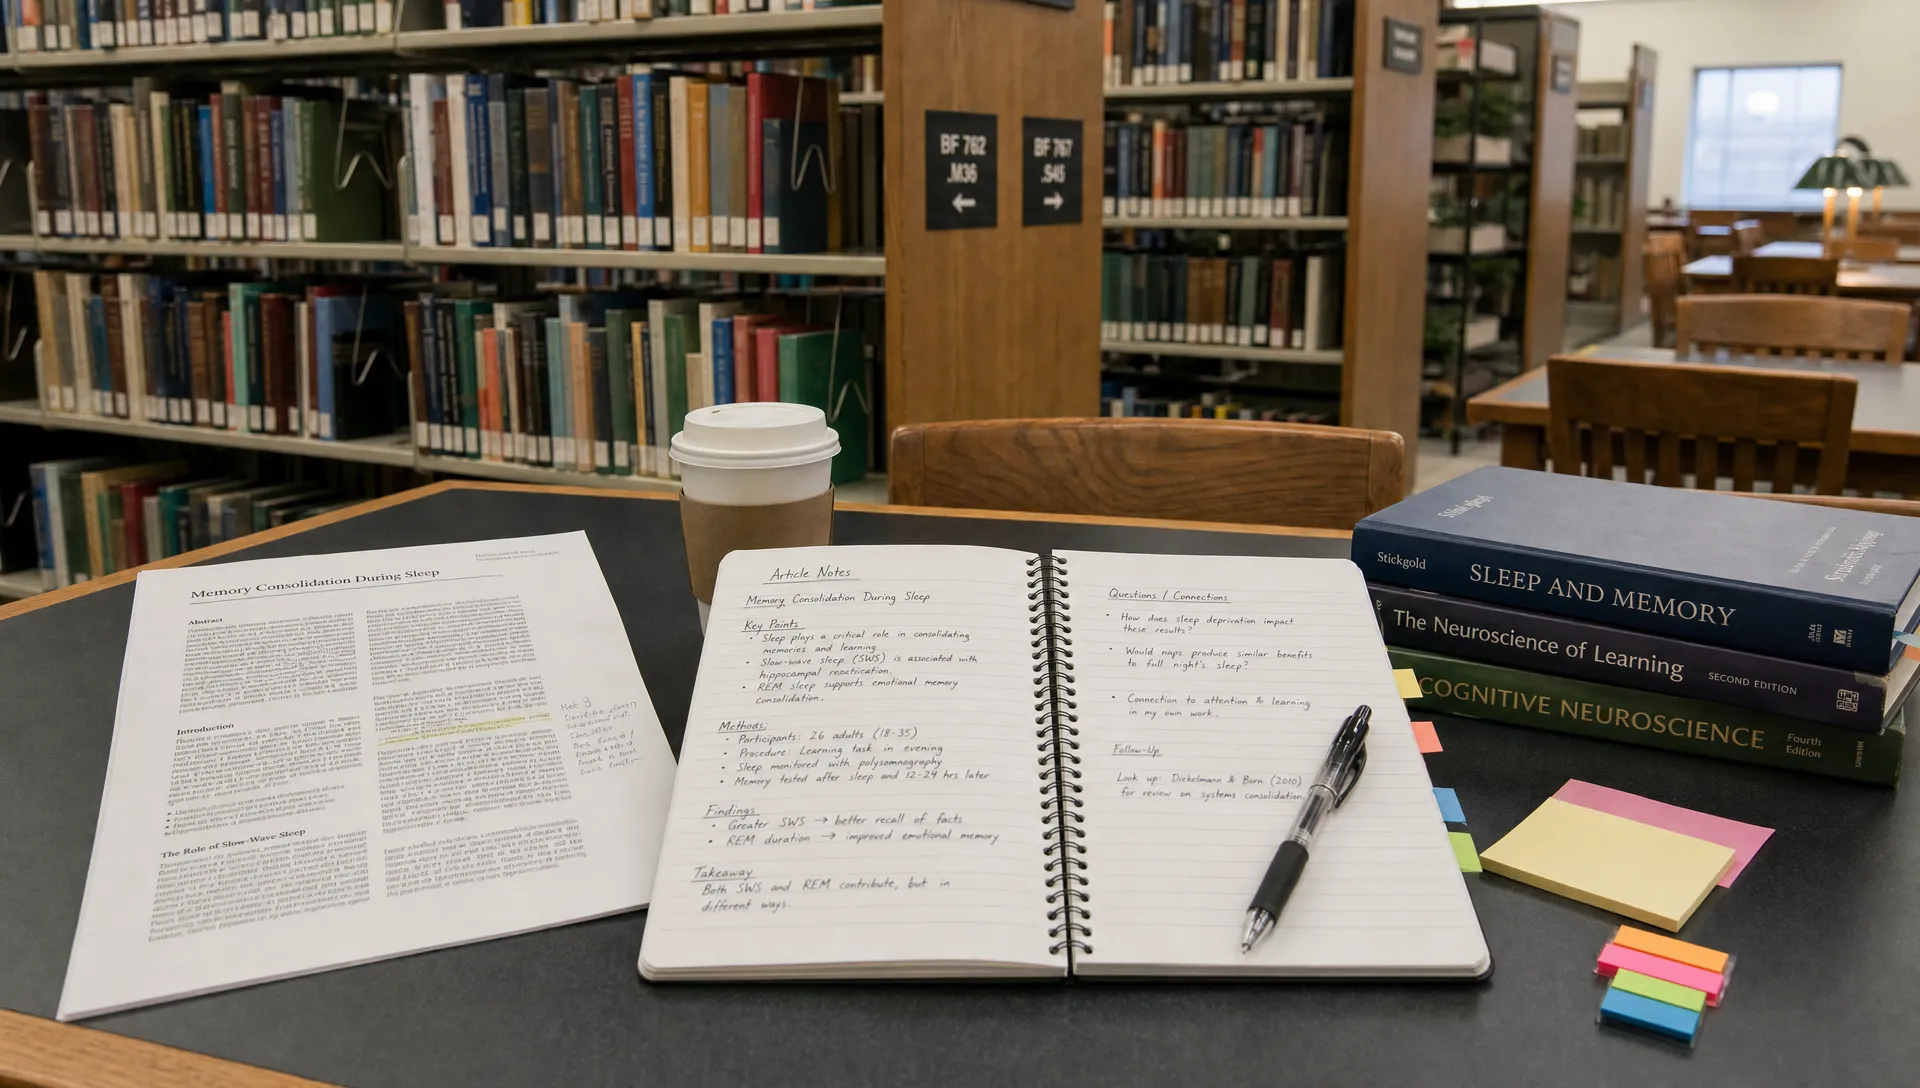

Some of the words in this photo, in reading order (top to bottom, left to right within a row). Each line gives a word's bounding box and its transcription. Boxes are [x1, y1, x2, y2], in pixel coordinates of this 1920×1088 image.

[940, 133, 959, 154] BF
[963, 135, 987, 156] 762
[1034, 138, 1051, 157] BF
[947, 163, 978, 183] .M36
[1377, 550, 1427, 570] Stickgold
[770, 567, 810, 581] Article
[817, 565, 851, 578] Notes
[191, 586, 252, 599] Memory
[256, 576, 351, 592] Consolidation
[355, 572, 401, 586] During
[405, 570, 440, 581] Sleep
[792, 593, 855, 604] Consolidation
[863, 592, 897, 606] During
[904, 590, 931, 603] Sleep
[1109, 588, 1157, 600] Questions
[1163, 589, 1168, 600] /
[1173, 591, 1228, 602] Connections
[1470, 564, 1541, 592] SLEEP
[1547, 579, 1605, 605] AND
[1612, 588, 1736, 628] MEMORY
[188, 617, 223, 626] Abstract
[744, 620, 763, 635] Key
[769, 619, 799, 629] Points
[1121, 613, 1140, 622] How
[1148, 614, 1167, 623] does
[1176, 615, 1200, 626] sleep
[1207, 615, 1256, 627] deprivation
[1264, 617, 1295, 626] impact
[1124, 625, 1147, 633] these
[1155, 626, 1193, 634] results?
[762, 632, 786, 645] Sleep
[790, 633, 814, 644] plays
[833, 630, 865, 639] critical
[872, 630, 889, 638] role
[913, 630, 970, 641] consolidating
[763, 645, 806, 654] memories
[815, 643, 832, 651] and
[1126, 647, 1154, 656] Would
[1161, 650, 1183, 660] naps
[1192, 650, 1228, 660] produce
[1237, 650, 1268, 658] similar
[1276, 650, 1313, 659] benefits
[1393, 609, 1427, 631] The
[1434, 616, 1558, 656] Neuroscience
[1566, 640, 1587, 659] of
[1594, 645, 1684, 683] Learning
[760, 657, 812, 666] Slow-wave
[820, 655, 844, 667] sleep
[852, 652, 886, 664] (SWS)
[893, 655, 901, 663] is
[908, 654, 952, 663] associated
[959, 655, 977, 663] with
[1128, 658, 1137, 667] to
[1147, 659, 1164, 667] full
[1174, 659, 1206, 671] night's
[1217, 660, 1249, 671] sleep?
[759, 667, 821, 683] hippocampal
[757, 682, 782, 691] REM
[790, 681, 816, 693] sleep
[824, 678, 863, 690] supports
[872, 678, 917, 687] emotional
[925, 679, 958, 690] memory
[1708, 671, 1749, 690] SECOND
[1753, 678, 1797, 695] EDITION
[756, 693, 824, 704] consolidation.
[1128, 694, 1177, 704] Connection
[1187, 695, 1196, 704] to
[1204, 696, 1248, 705] attention
[1145, 711, 1157, 719] my
[1419, 677, 1550, 715] COGNITIVE
[1560, 699, 1765, 749] NEUROSCIENCE
[176, 723, 234, 735] Introduction
[738, 732, 801, 745] Participants:
[809, 730, 825, 740] 26
[832, 729, 864, 740] adults
[873, 726, 918, 740] (18-35)
[1787, 733, 1821, 746] Fourth
[739, 746, 792, 758] Procedure:
[800, 744, 843, 758] Learning
[852, 744, 873, 753] task
[884, 744, 893, 752] in
[904, 742, 943, 756] evening
[1114, 744, 1160, 758] Follow-Up
[1785, 744, 1821, 759] Edition
[737, 761, 762, 774] Sleep
[770, 759, 819, 770] monitored
[828, 758, 850, 767] with
[858, 757, 942, 770] polysomnography
[734, 776, 771, 788] Memory
[780, 774, 807, 783] tested
[816, 773, 840, 782] after
[849, 771, 874, 784] sleep
[881, 770, 899, 780] and
[906, 769, 937, 780] 12-24
[943, 769, 958, 779] hrs
[965, 769, 990, 779] later
[1117, 773, 1137, 783] Look
[1228, 775, 1236, 783] &
[1242, 775, 1263, 784] Born
[1270, 775, 1302, 786] (2010)
[1121, 787, 1135, 797] for
[1143, 789, 1171, 798] review
[1201, 790, 1236, 801] systems
[1245, 791, 1305, 801] consolidation.
[706, 805, 755, 819] Findings
[729, 819, 769, 831] Greater
[780, 816, 805, 827] SWS
[834, 814, 867, 825] better
[875, 813, 904, 824] recall
[914, 812, 928, 824] of
[936, 812, 963, 824] facts
[161, 850, 181, 859] The
[183, 844, 206, 855] Role
[209, 842, 220, 850] of
[222, 834, 277, 847] Slow-Wave
[279, 828, 306, 840] Sleep
[727, 834, 755, 845] REM
[765, 833, 810, 844] duration
[845, 830, 892, 843] improved
[902, 829, 951, 840] emotional
[961, 832, 1000, 845] memory
[694, 866, 753, 881] Takeaway
[702, 884, 727, 896] Both
[736, 881, 762, 893] SWS
[771, 881, 792, 892] and
[803, 879, 830, 890] REM
[839, 877, 899, 891] contribute,
[907, 877, 927, 888] but
[940, 879, 950, 888] in
[702, 899, 752, 912] different
